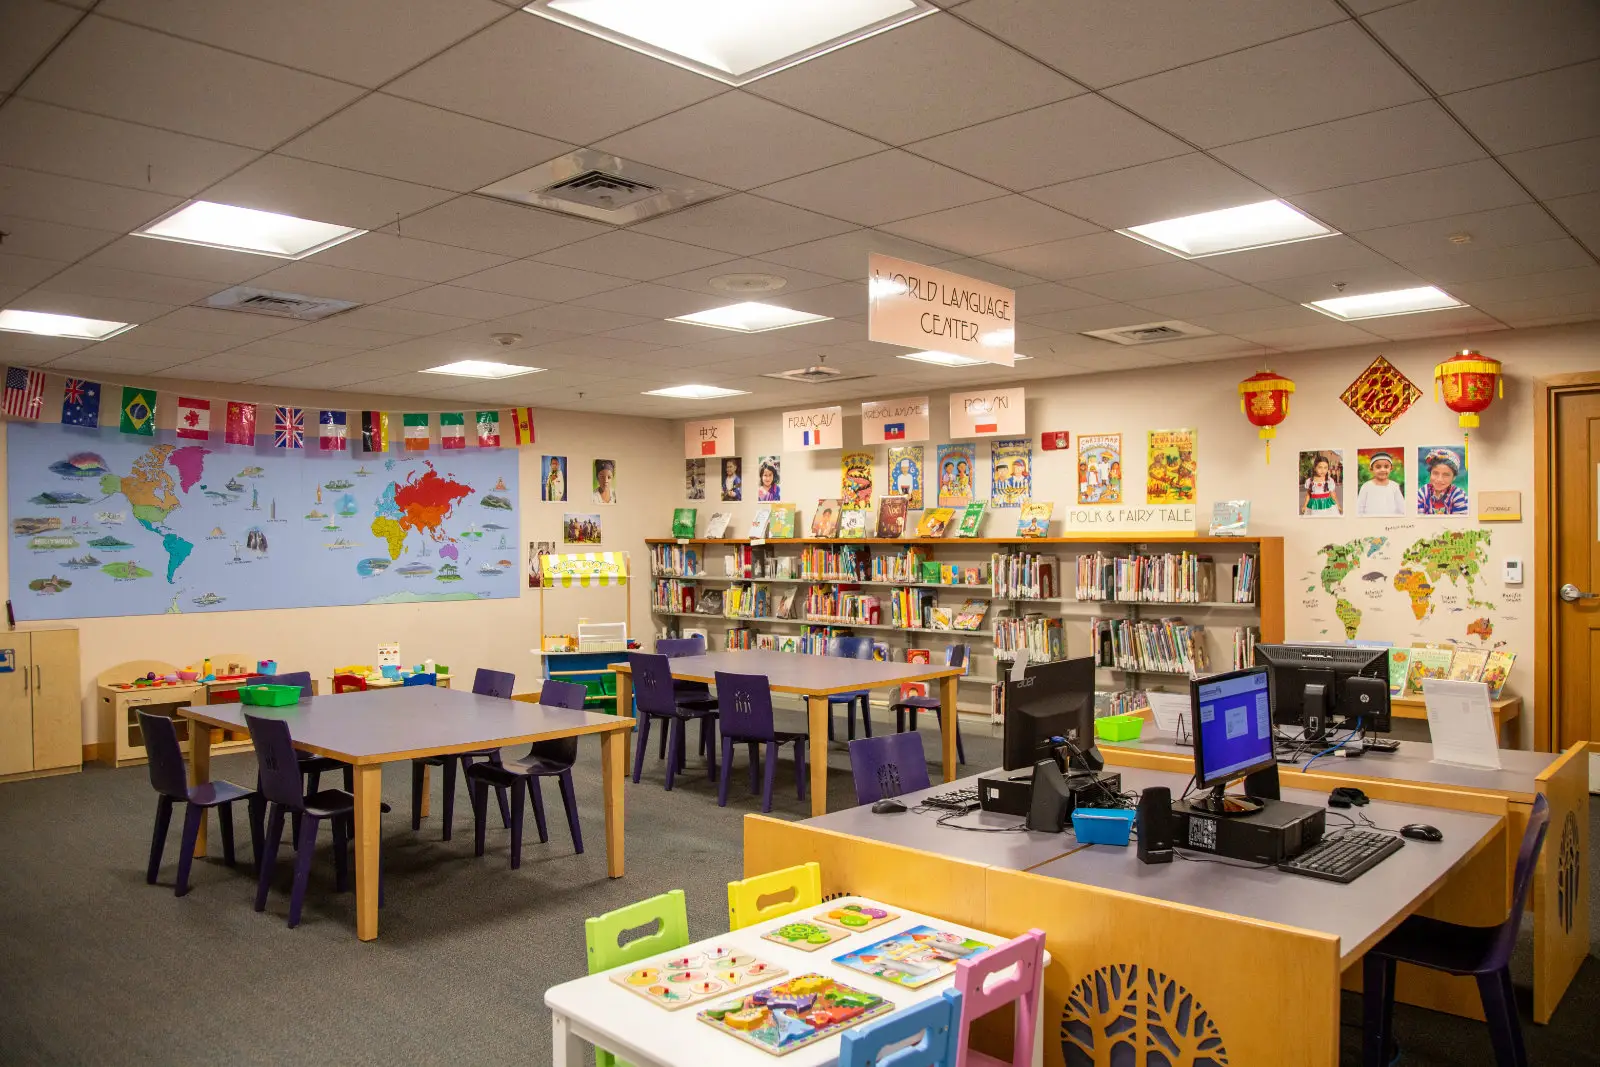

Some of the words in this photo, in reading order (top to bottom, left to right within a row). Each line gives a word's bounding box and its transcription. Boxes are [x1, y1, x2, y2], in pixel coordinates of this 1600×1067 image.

[875, 269, 938, 302] ORLD
[942, 284, 1011, 321] LANGUAGE
[920, 312, 979, 343] CENTER
[964, 396, 1009, 412] POLSKI
[788, 412, 836, 429] FRANÇAIS
[699, 425, 718, 440] 中文
[1069, 510, 1101, 523] FOLK
[1105, 510, 1115, 523] &
[1119, 508, 1155, 522] FAIRY
[1158, 508, 1193, 522] TALE
[1017, 676, 1036, 688] acer
